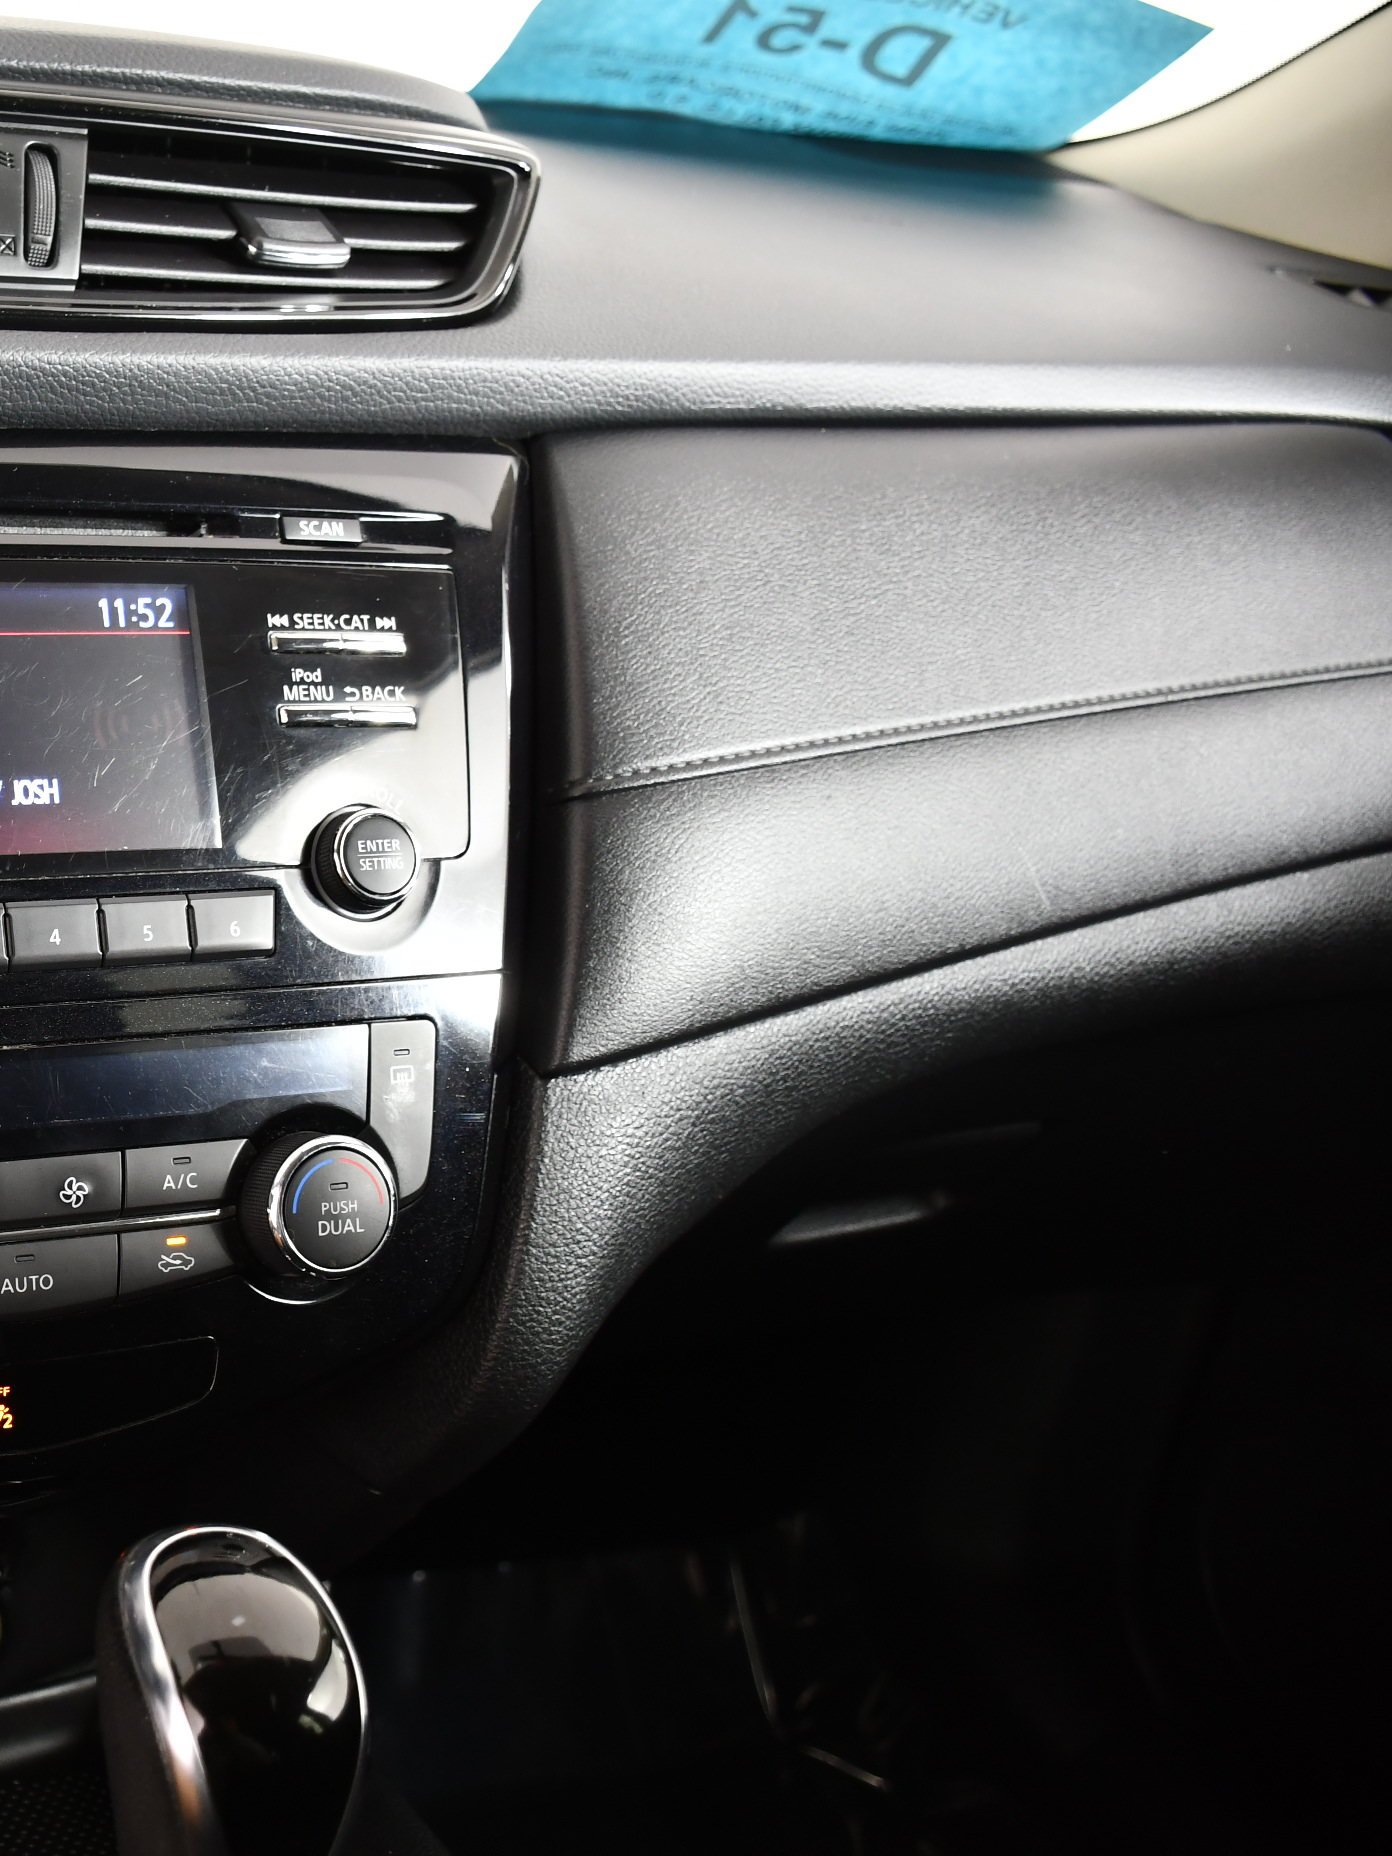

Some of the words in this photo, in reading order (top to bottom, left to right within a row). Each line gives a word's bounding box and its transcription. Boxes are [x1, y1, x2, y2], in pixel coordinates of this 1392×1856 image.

[299, 521, 344, 536] SCAN
[99, 594, 174, 628] 11:52
[291, 668, 321, 682] iPod
[283, 685, 334, 701] MENU
[362, 686, 406, 701] BACK
[12, 779, 60, 805] JOSH
[358, 839, 400, 852] ENTER
[360, 858, 404, 871] SETTING
[50, 929, 61, 945] 4
[144, 925, 153, 941] 5
[230, 921, 240, 937] 6
[163, 1173, 197, 1189] A/C
[321, 1201, 358, 1214] PUSH
[319, 1218, 365, 1236] DUAL
[1, 1274, 53, 1294] AUTO
